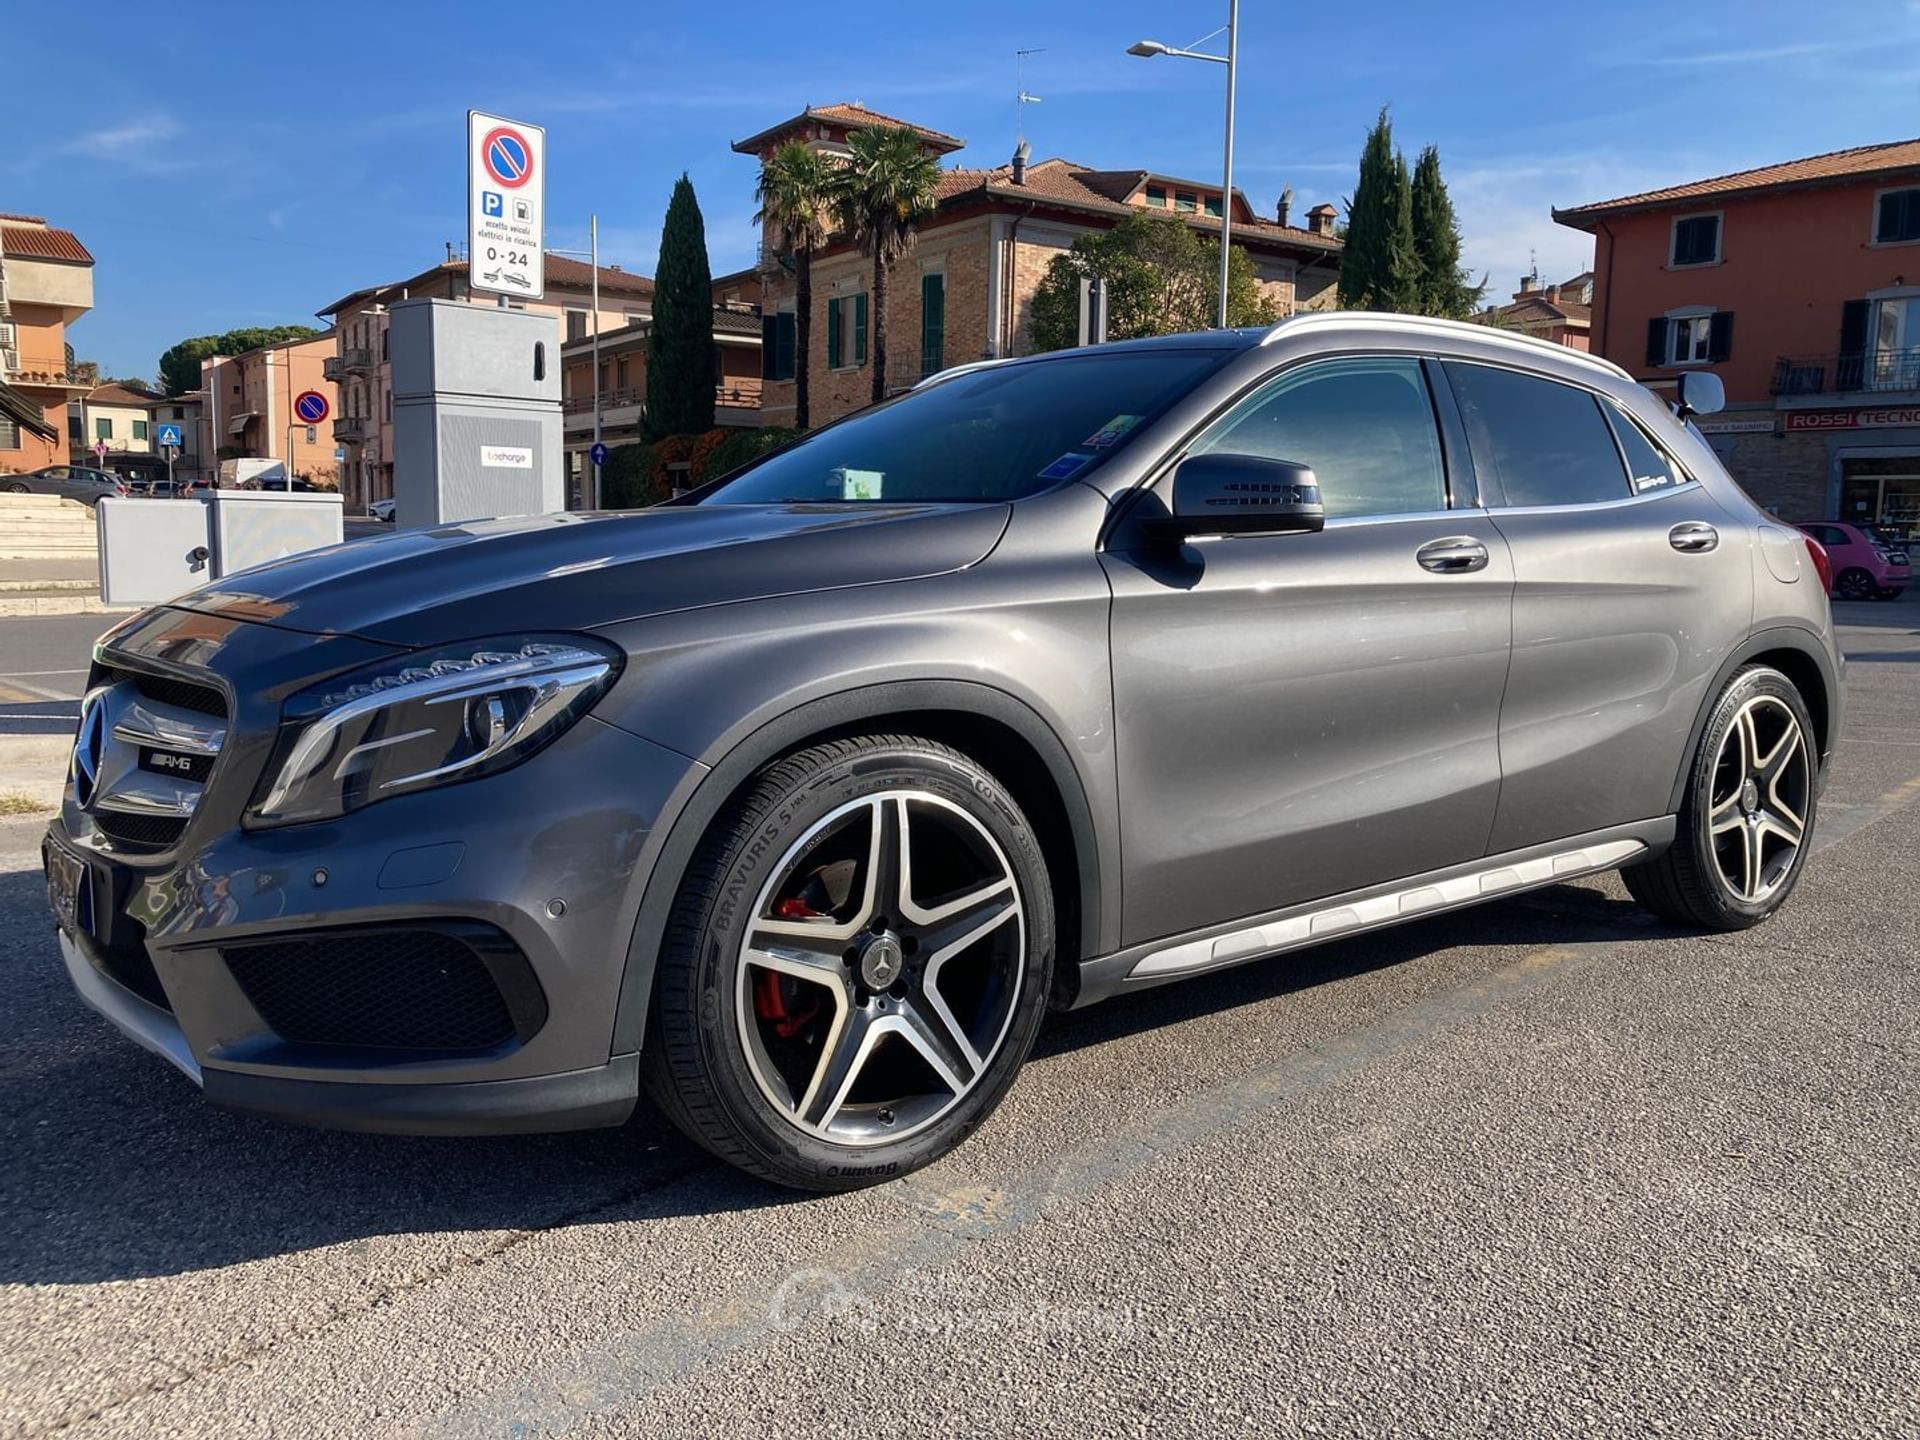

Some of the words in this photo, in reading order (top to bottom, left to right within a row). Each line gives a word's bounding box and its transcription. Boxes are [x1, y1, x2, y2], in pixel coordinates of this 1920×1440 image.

[486, 221, 508, 230] eccetto
[510, 226, 531, 235] veicoli
[478, 229, 504, 241] elettrici
[506, 233, 512, 242] in
[514, 237, 537, 248] ricarica
[1792, 413, 1853, 427] ROSSI
[160, 754, 192, 770] AMG
[715, 823, 779, 931] BRAVURIS
[779, 809, 792, 826] 5
[839, 1161, 899, 1177] Barum
